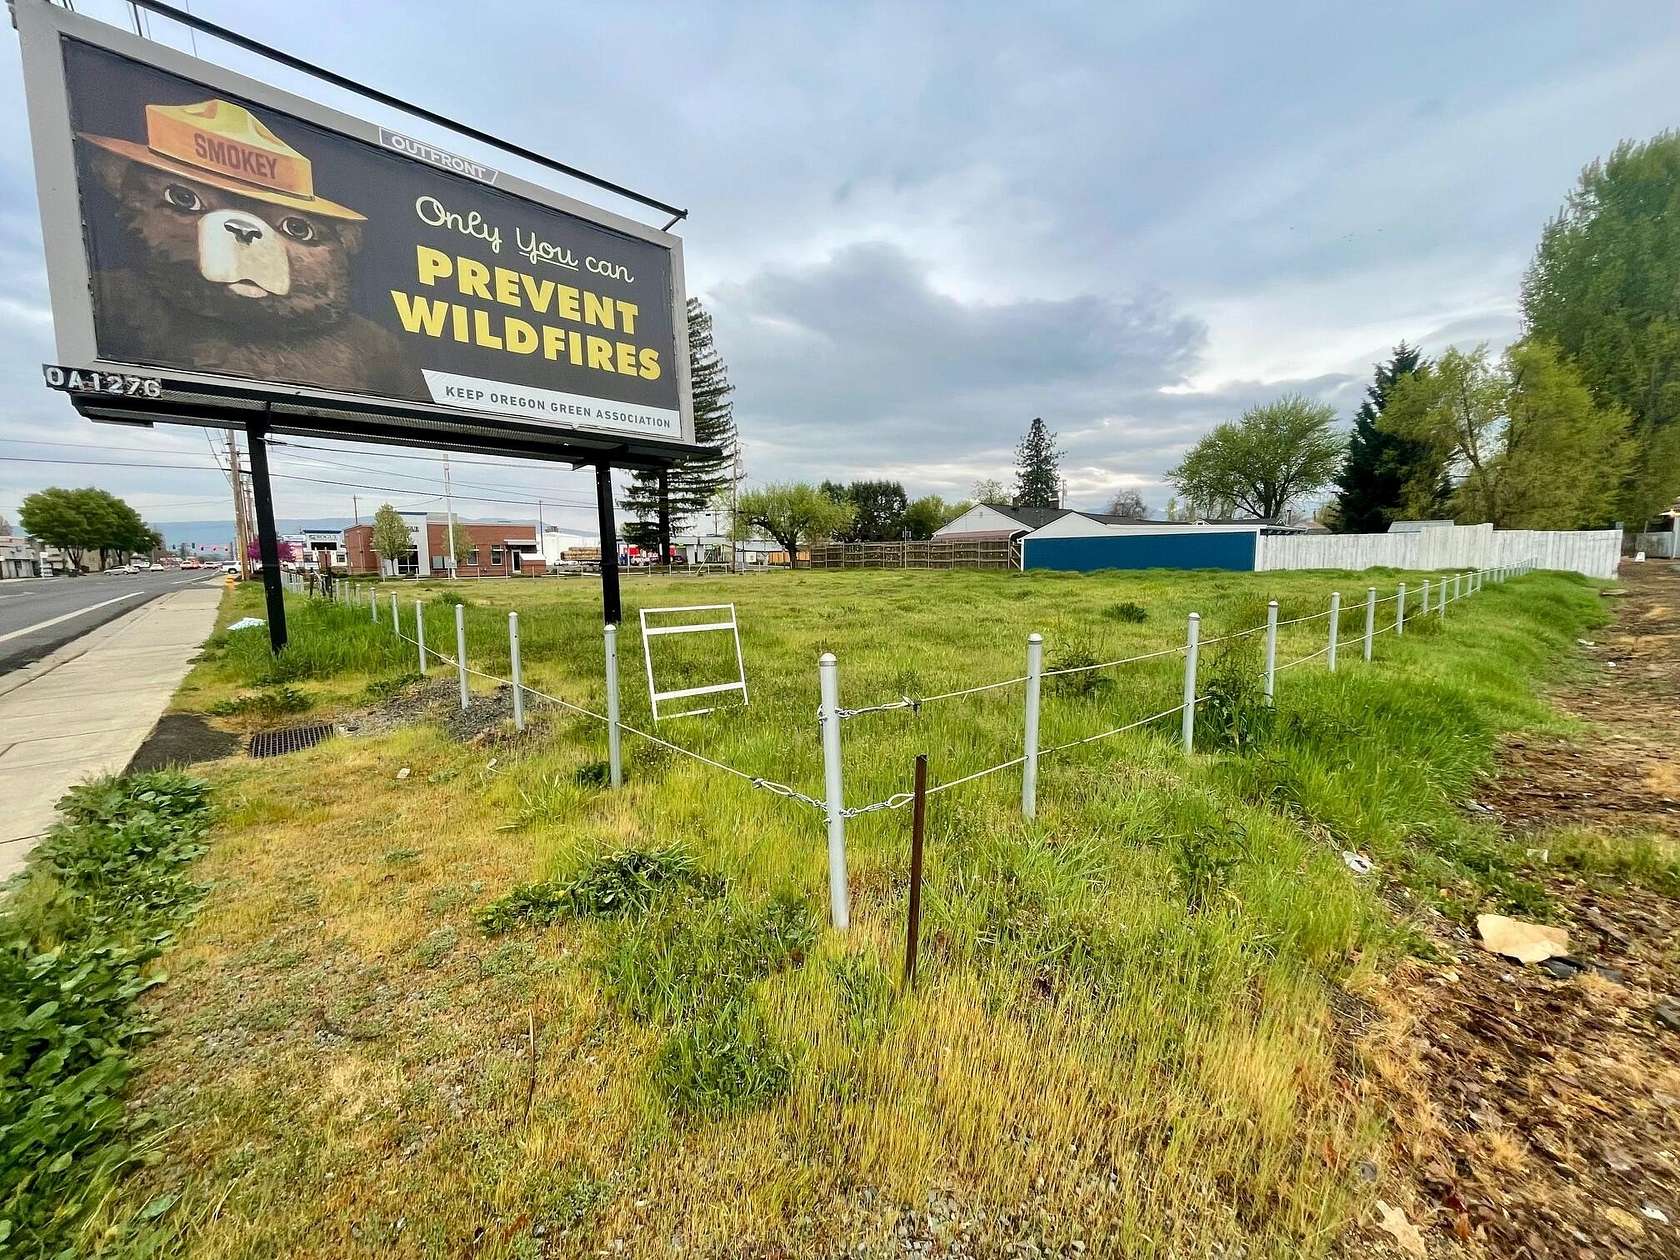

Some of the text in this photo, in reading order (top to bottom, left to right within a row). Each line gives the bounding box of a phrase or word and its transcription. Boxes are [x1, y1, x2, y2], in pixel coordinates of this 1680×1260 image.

[194, 132, 277, 179] SMOKEY
[391, 135, 486, 179] OUTFRONT
[415, 195, 503, 254] Only
[585, 256, 635, 283] can
[416, 245, 639, 335] PREVENT
[390, 290, 662, 380] WILDFIRES
[445, 386, 671, 429] KEEP OREGON GREEN ASSOCIATION
